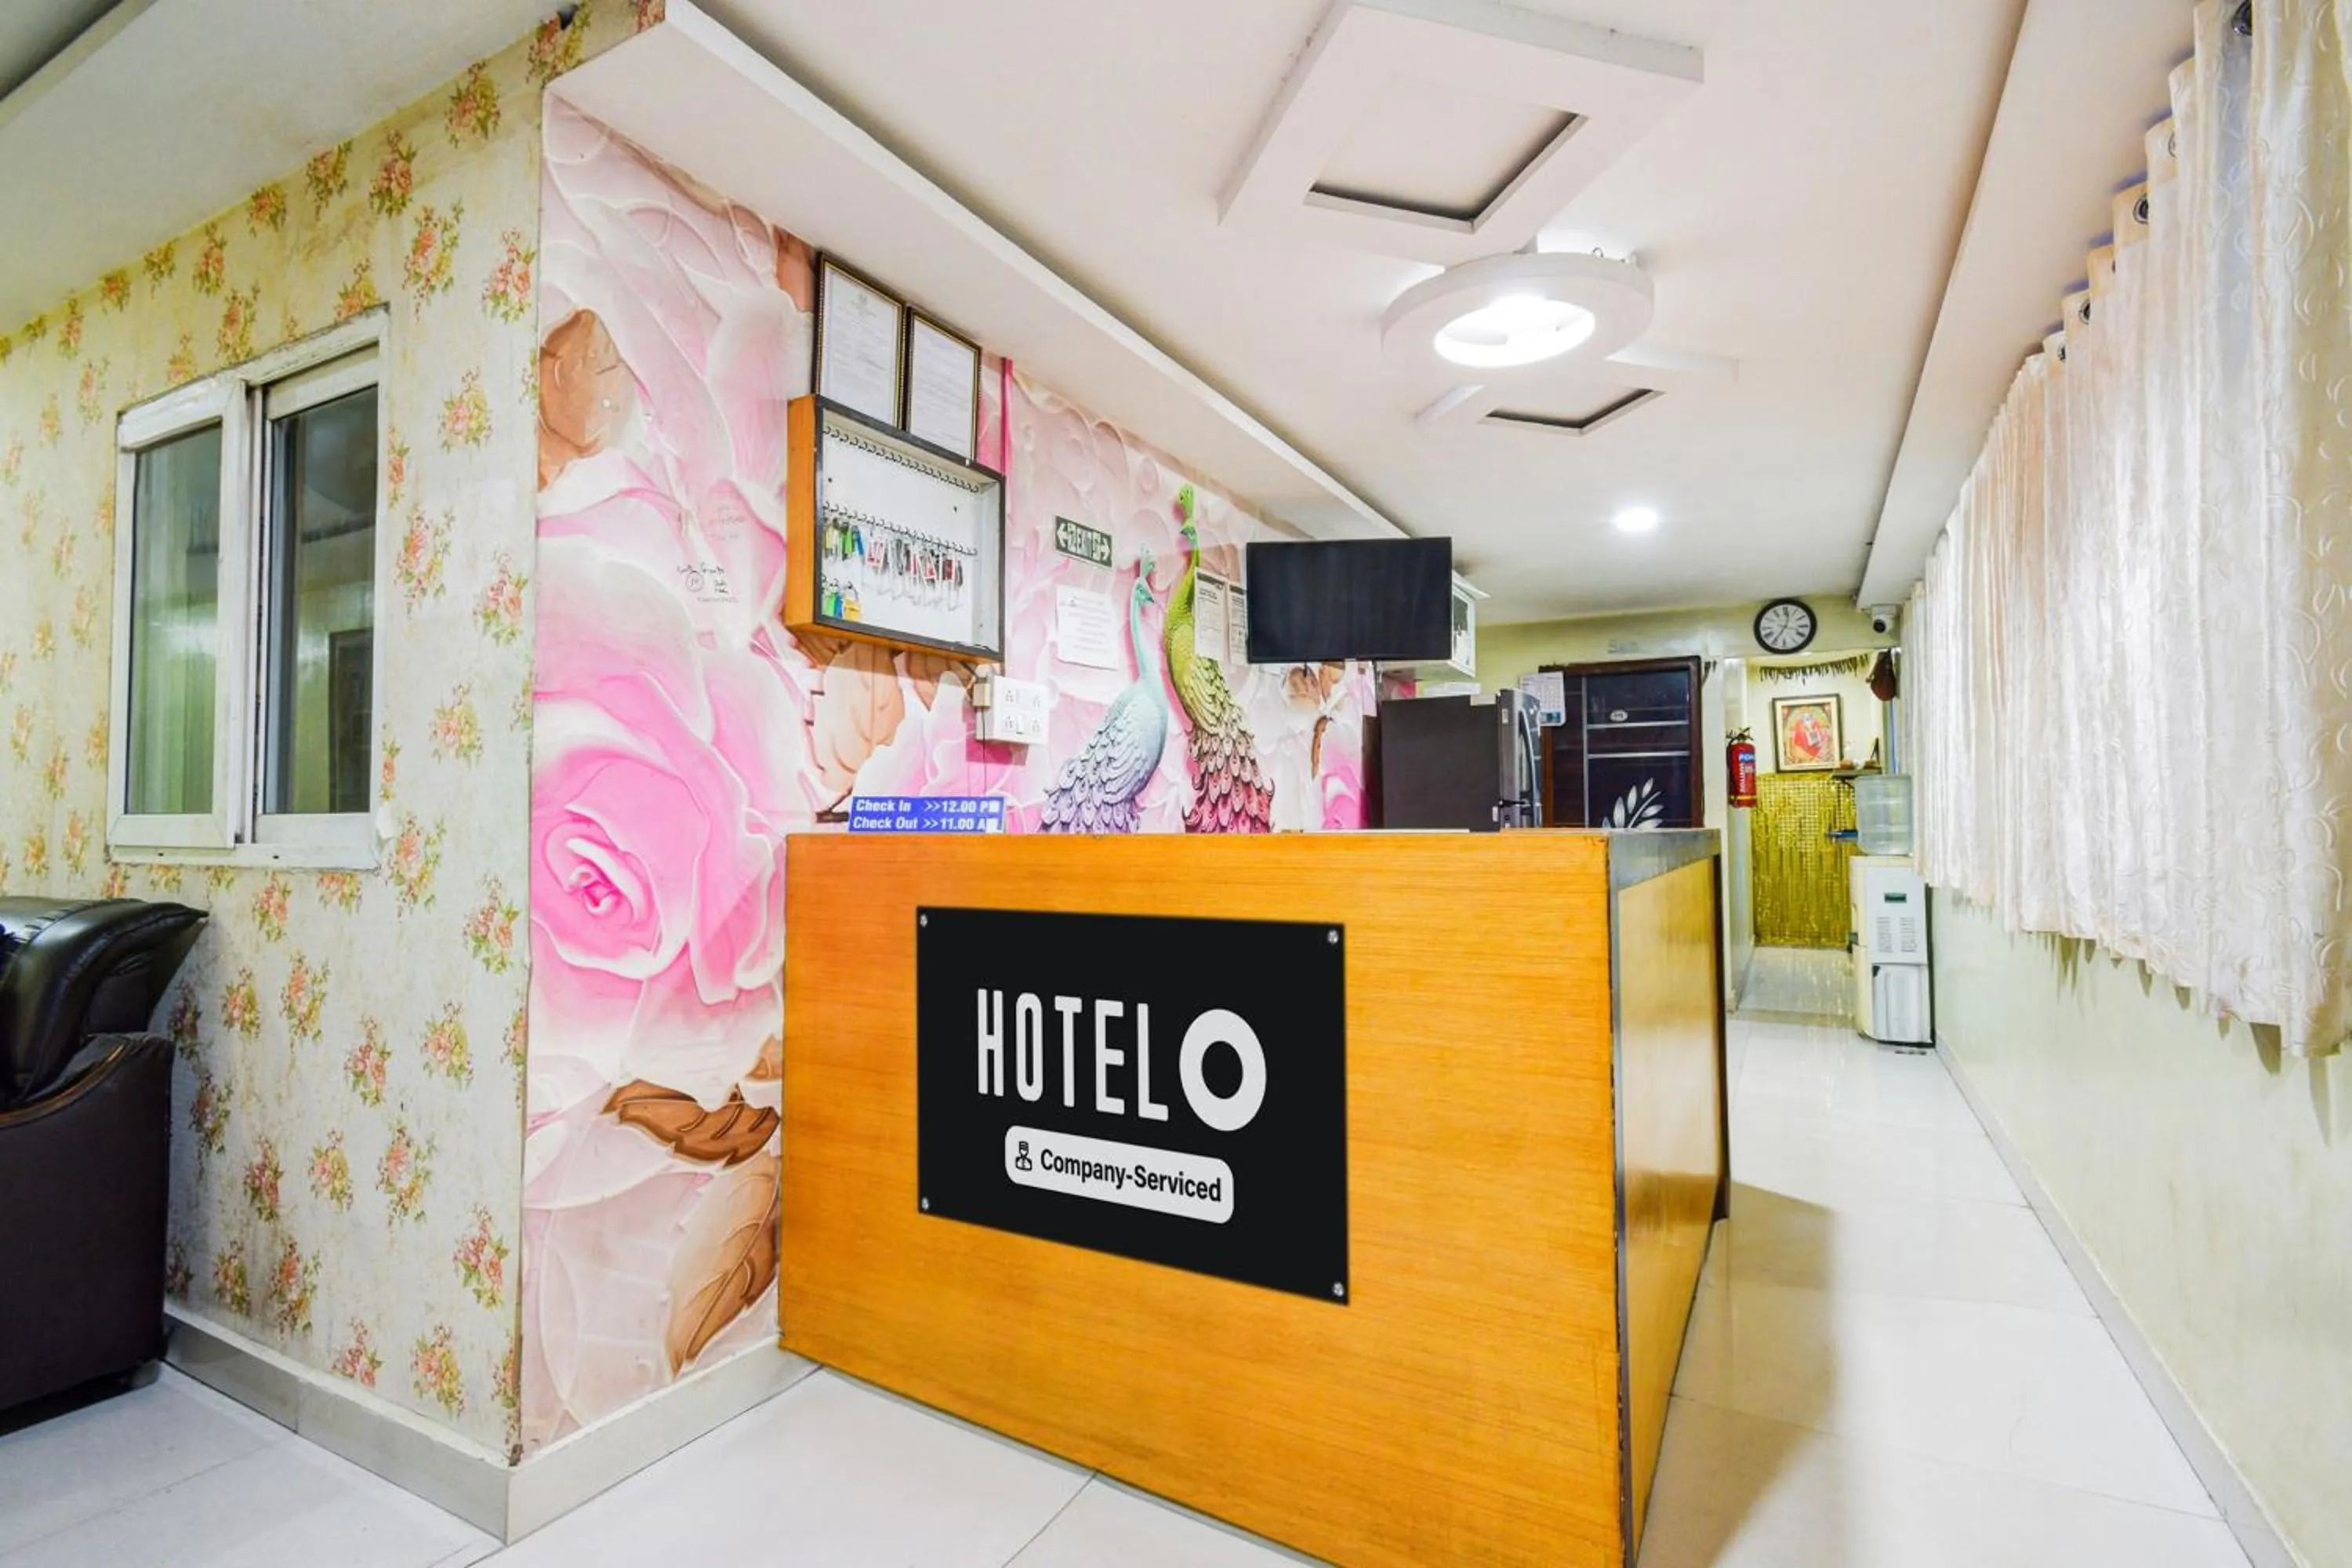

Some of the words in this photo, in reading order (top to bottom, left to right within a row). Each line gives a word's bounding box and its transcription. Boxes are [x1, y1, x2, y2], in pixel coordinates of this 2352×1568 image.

[856, 799, 895, 812] Check
[899, 800, 912, 811] In
[853, 816, 891, 829] Check
[896, 816, 918, 829] Out
[977, 818, 998, 830] A
[1040, 1149, 1221, 1203] Company-Serviced
